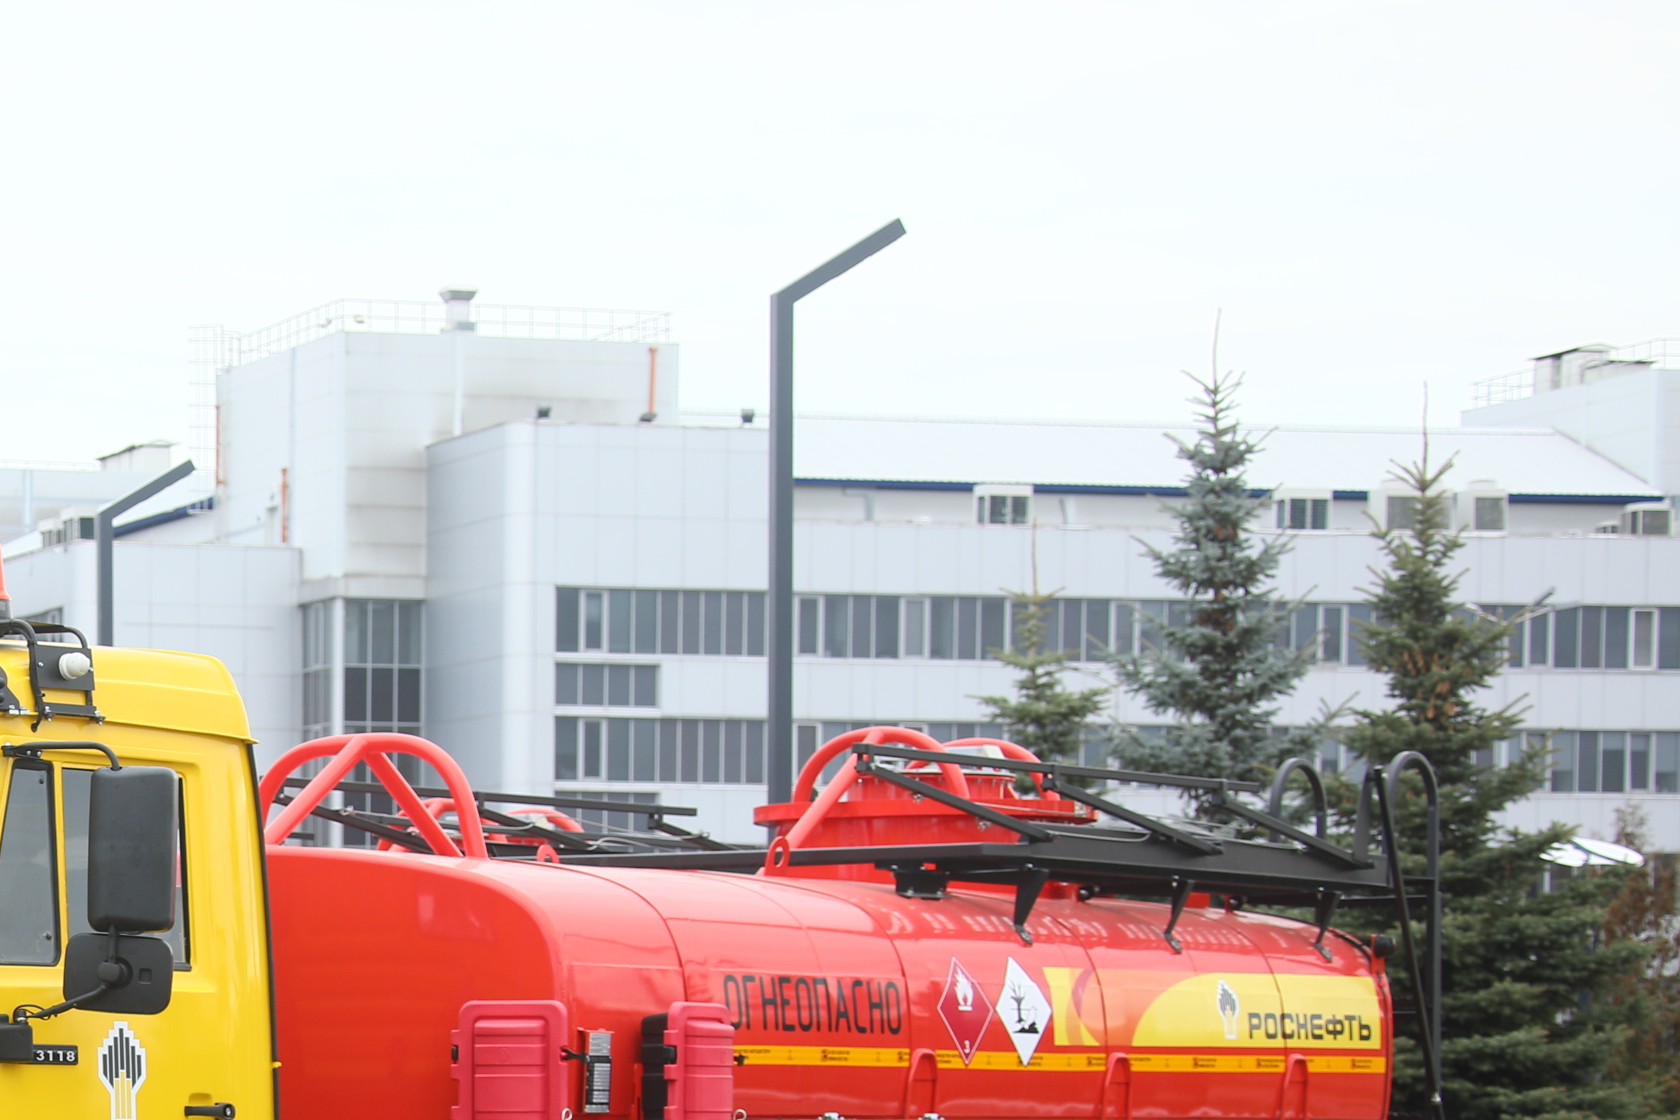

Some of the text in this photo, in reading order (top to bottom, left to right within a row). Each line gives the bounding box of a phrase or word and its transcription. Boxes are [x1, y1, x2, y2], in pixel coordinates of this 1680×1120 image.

[723, 974, 902, 1035] ОГНЕОПАСНО
[1247, 1012, 1372, 1041] РОСНЕФТЬ
[36, 1049, 76, 1062] 3118
[963, 1039, 971, 1054] 3
